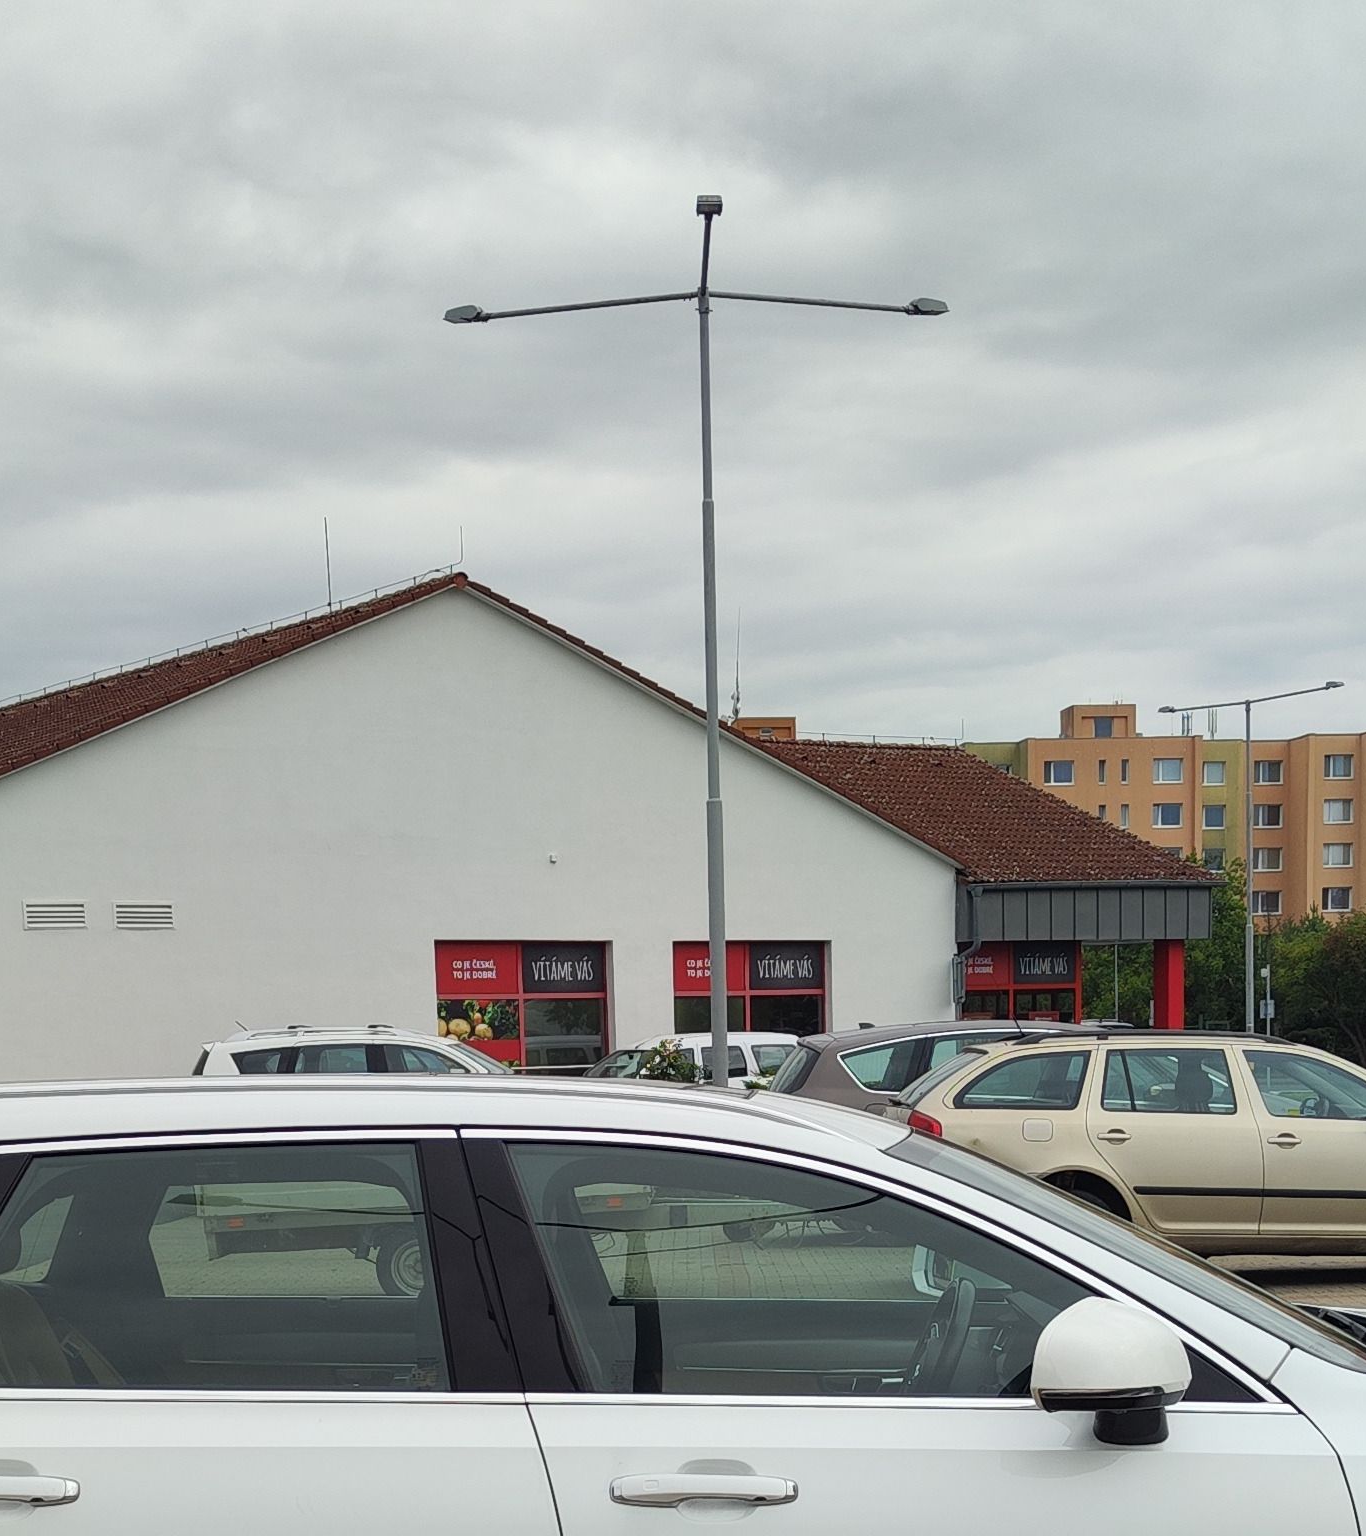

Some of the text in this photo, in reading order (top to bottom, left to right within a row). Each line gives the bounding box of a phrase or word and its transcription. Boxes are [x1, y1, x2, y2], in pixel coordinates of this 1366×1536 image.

[453, 960, 462, 969] CO
[463, 960, 471, 970] JE
[532, 956, 594, 981] VÍTÁME VÁS
[687, 960, 695, 968] CO
[757, 955, 813, 979] VÍTÁME VÁS
[1020, 953, 1068, 974] VÍTÁME VÁS
[453, 970, 462, 979] TO
[463, 970, 471, 981] JE
[687, 969, 695, 977] TO
